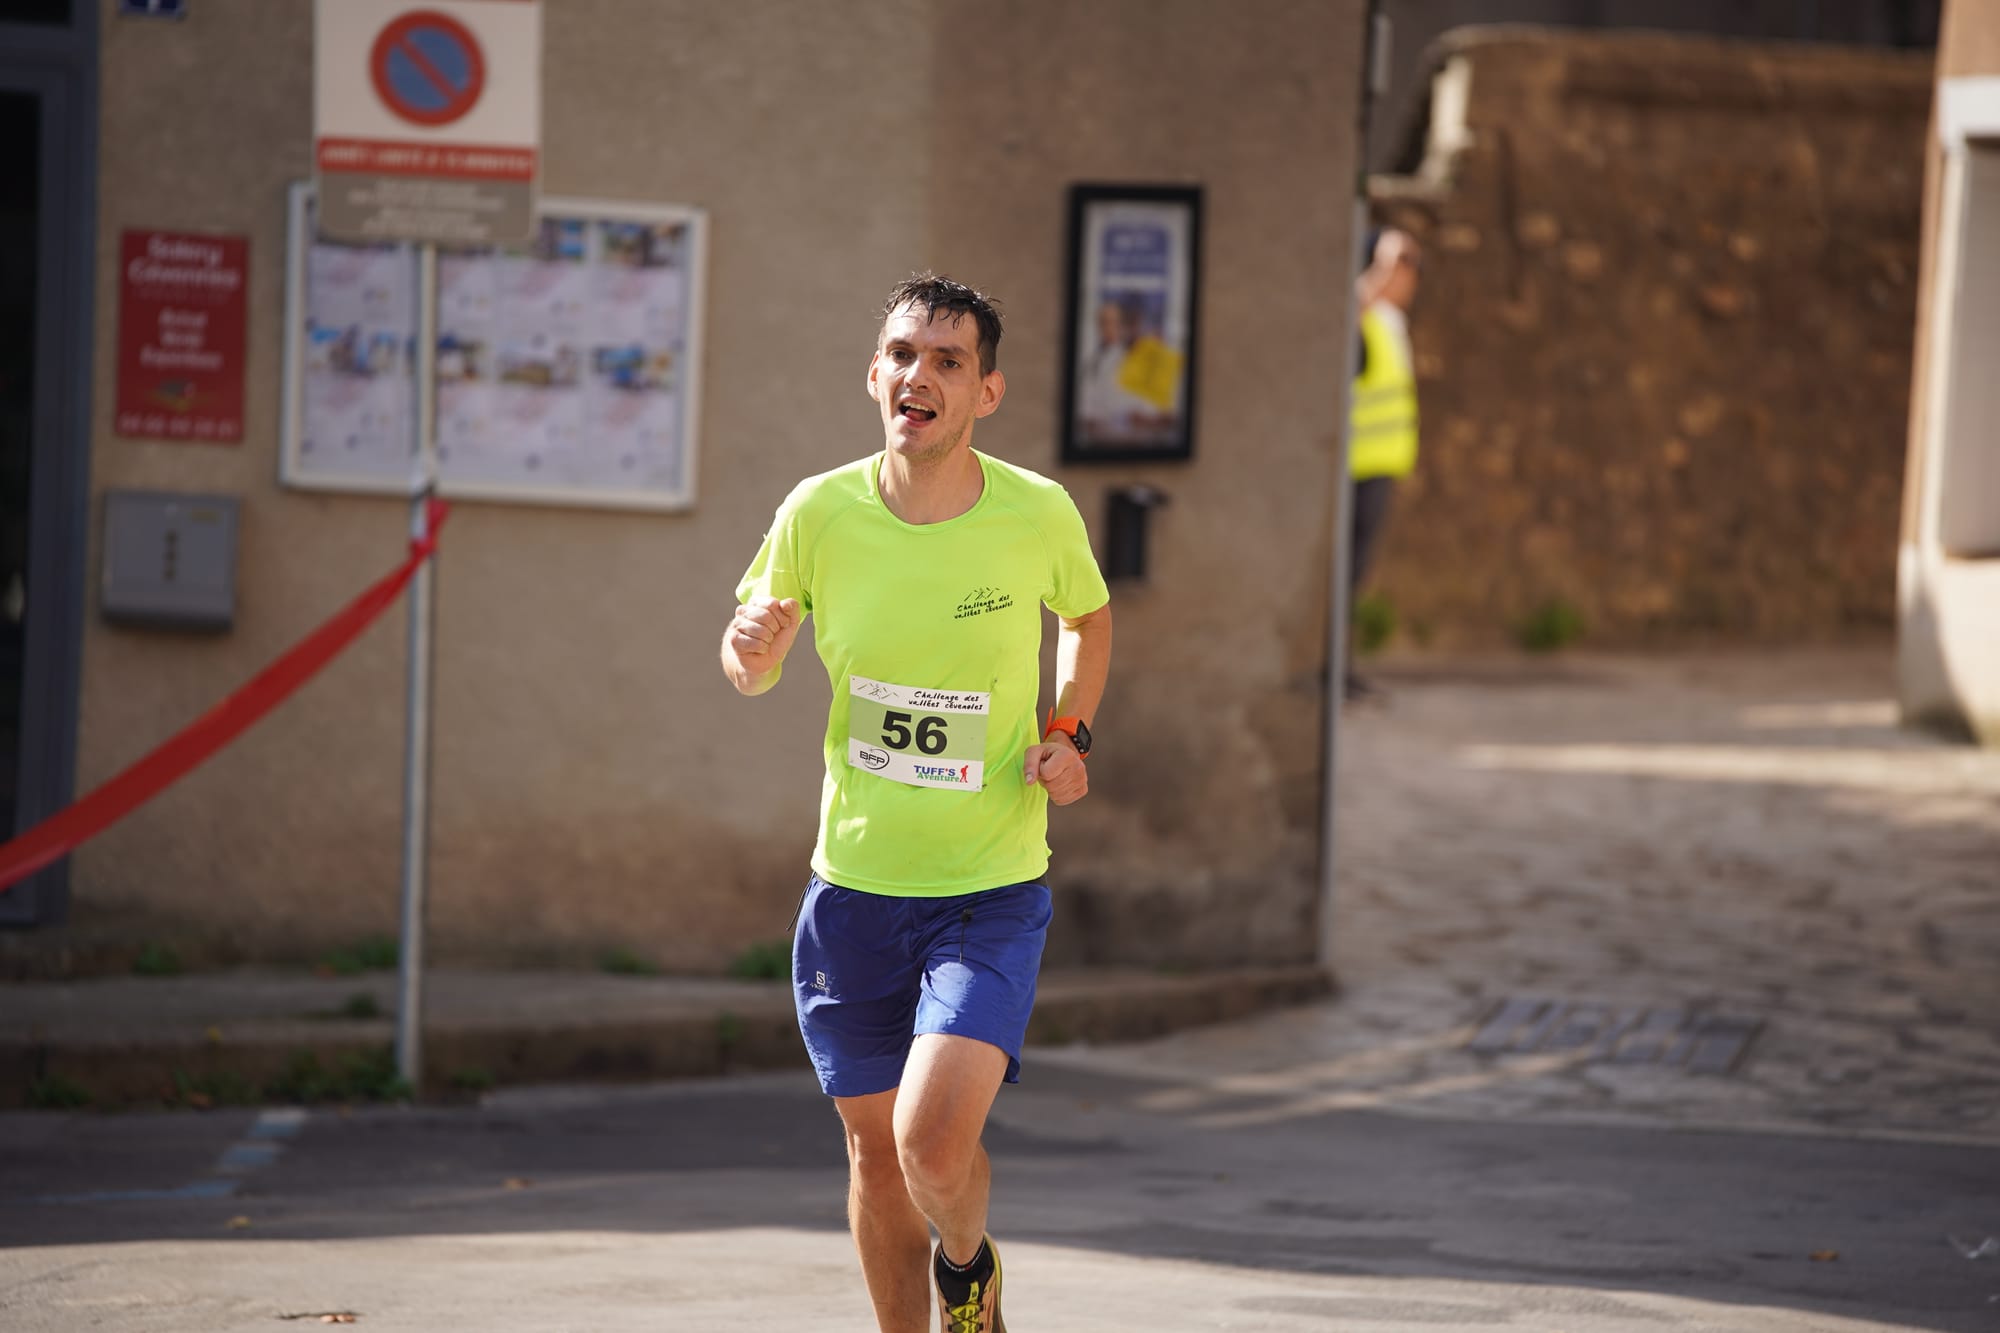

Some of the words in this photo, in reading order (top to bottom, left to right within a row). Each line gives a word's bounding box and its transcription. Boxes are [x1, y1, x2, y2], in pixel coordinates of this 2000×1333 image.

[957, 599, 995, 611] Challenge
[999, 594, 1010, 602] des
[914, 690, 959, 703] Challenge
[944, 701, 983, 711] cévenoles
[881, 710, 948, 755] 56
[859, 750, 885, 764] BFP
[913, 765, 956, 777] TUFF'S
[917, 772, 960, 783] Aventure
